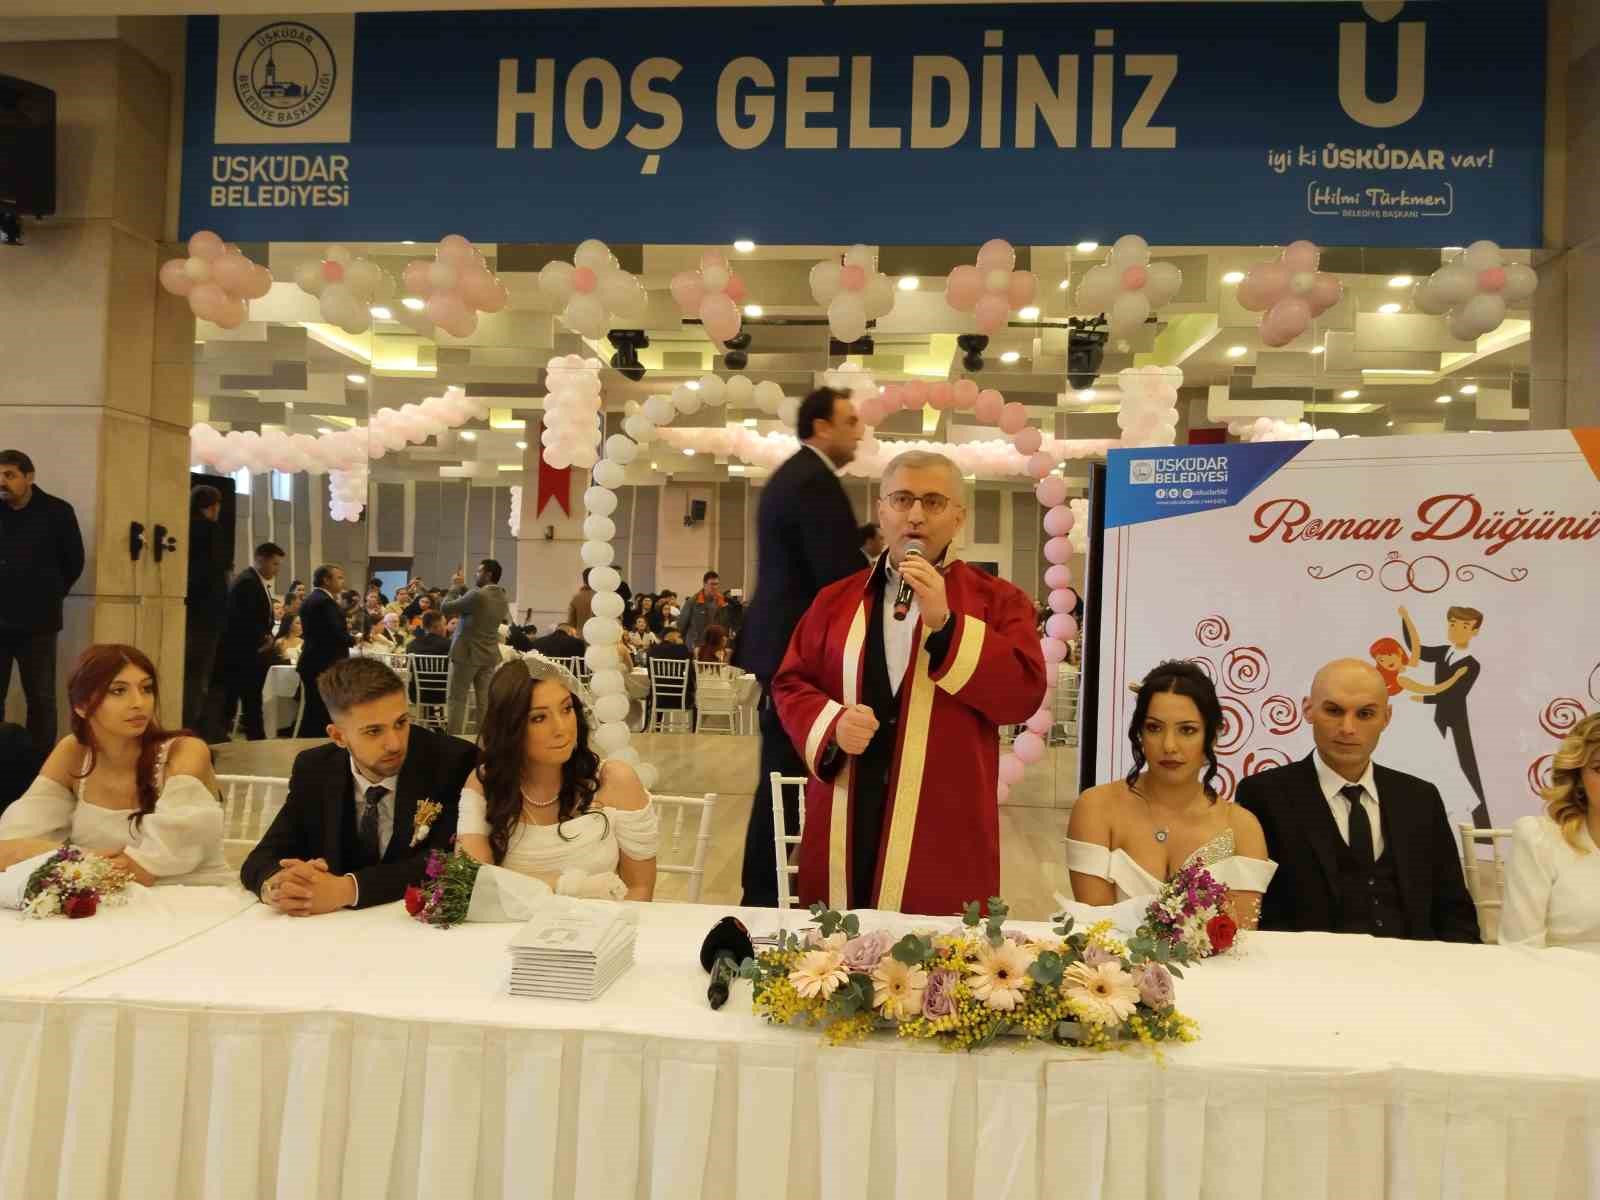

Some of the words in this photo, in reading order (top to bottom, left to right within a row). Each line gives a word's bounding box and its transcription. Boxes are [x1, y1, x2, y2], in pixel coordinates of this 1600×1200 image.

[496, 57, 684, 175] HOŞ
[716, 29, 1179, 150] GELDİNİZ
[212, 155, 349, 182] ÜSKÜDAR
[1268, 150, 1292, 173] iyi
[1299, 146, 1317, 166] ki
[1450, 149, 1495, 168] var!
[1314, 186, 1360, 206] Hilmi
[1365, 188, 1446, 206] Türkmen
[1156, 456, 1228, 472] ÜSKÜDAR
[1248, 498, 1403, 544] Roman
[1411, 494, 1600, 556] Düğünü
